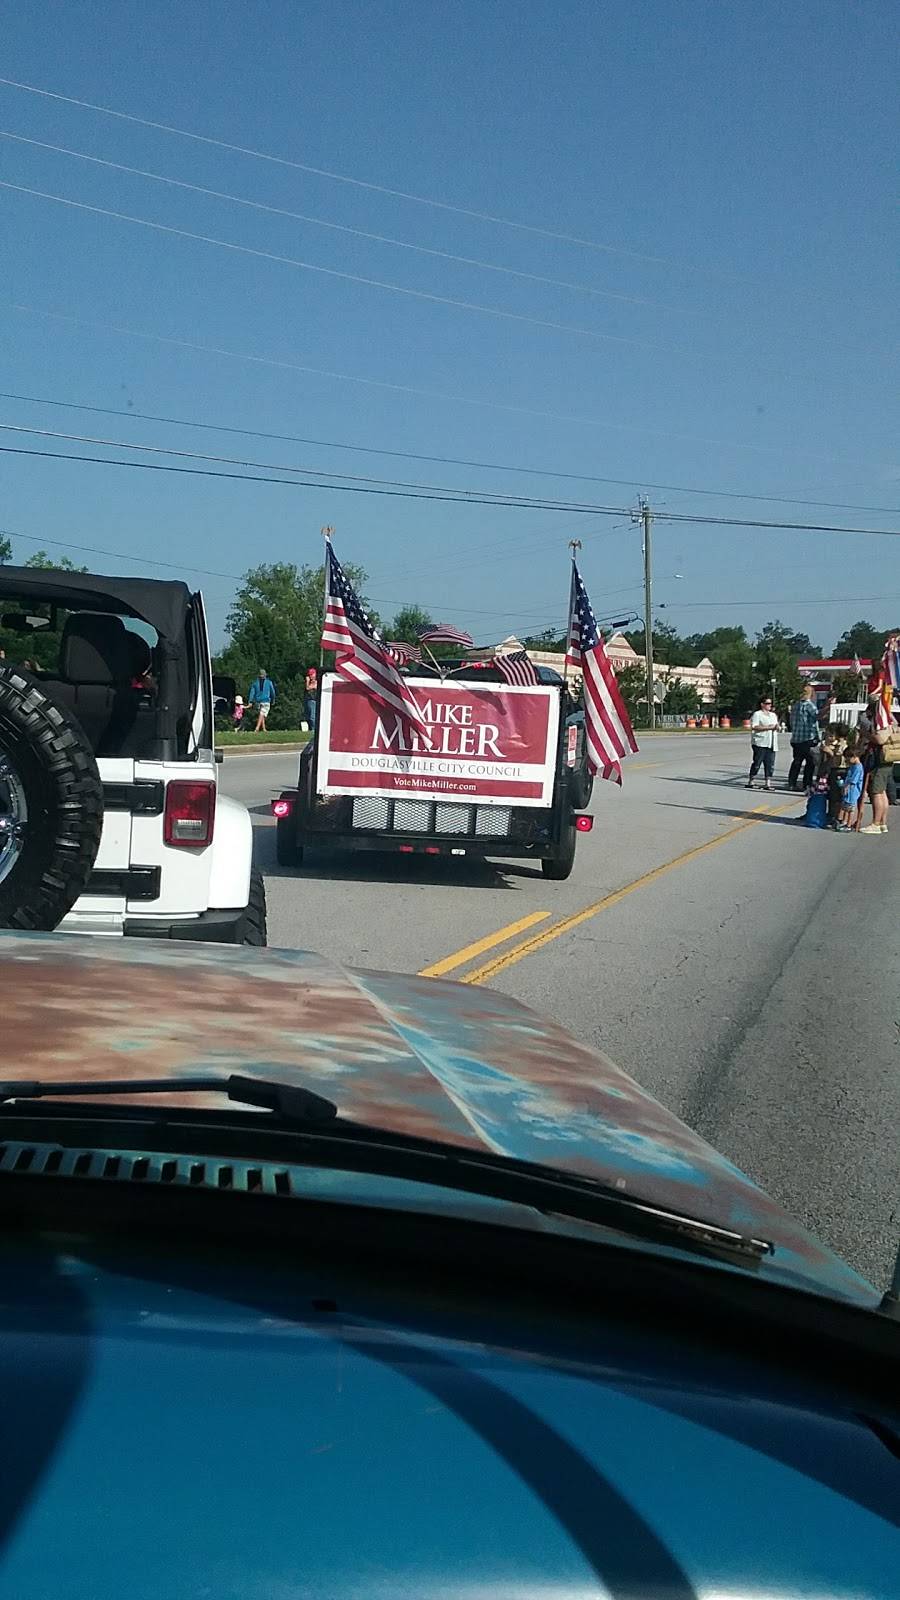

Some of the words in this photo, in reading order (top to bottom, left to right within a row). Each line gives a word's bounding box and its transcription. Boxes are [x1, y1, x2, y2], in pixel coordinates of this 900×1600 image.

[351, 757, 435, 773] DOUGLASVILLE
[438, 762, 467, 774] CITY
[468, 764, 522, 777] COUNCIL
[393, 777, 477, 791] VoteMikeMiller.com
